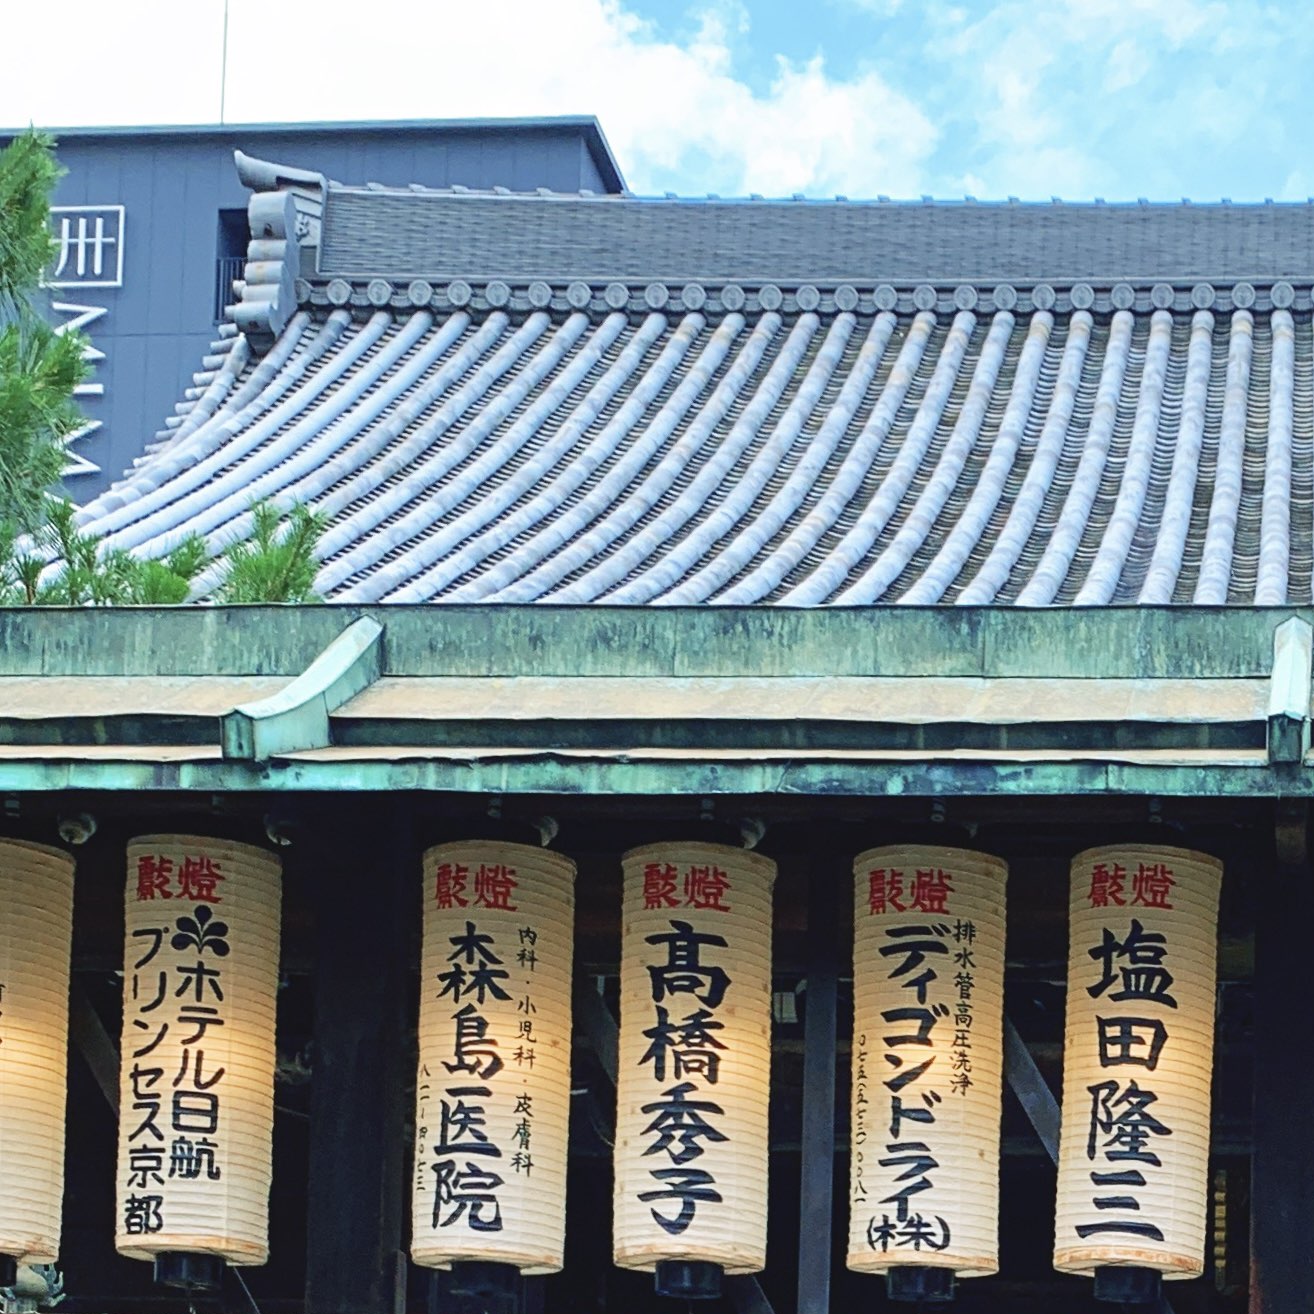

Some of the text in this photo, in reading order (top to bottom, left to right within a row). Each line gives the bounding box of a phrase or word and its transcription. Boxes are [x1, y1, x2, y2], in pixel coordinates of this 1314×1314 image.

[124, 926, 170, 1235] プリンセス京都
[168, 960, 225, 1182] ホテル日航
[431, 920, 514, 1232] 森島医院
[951, 919, 977, 1096] 排水管高圧洗浄
[1075, 918, 1178, 1242] 塩田隆三
